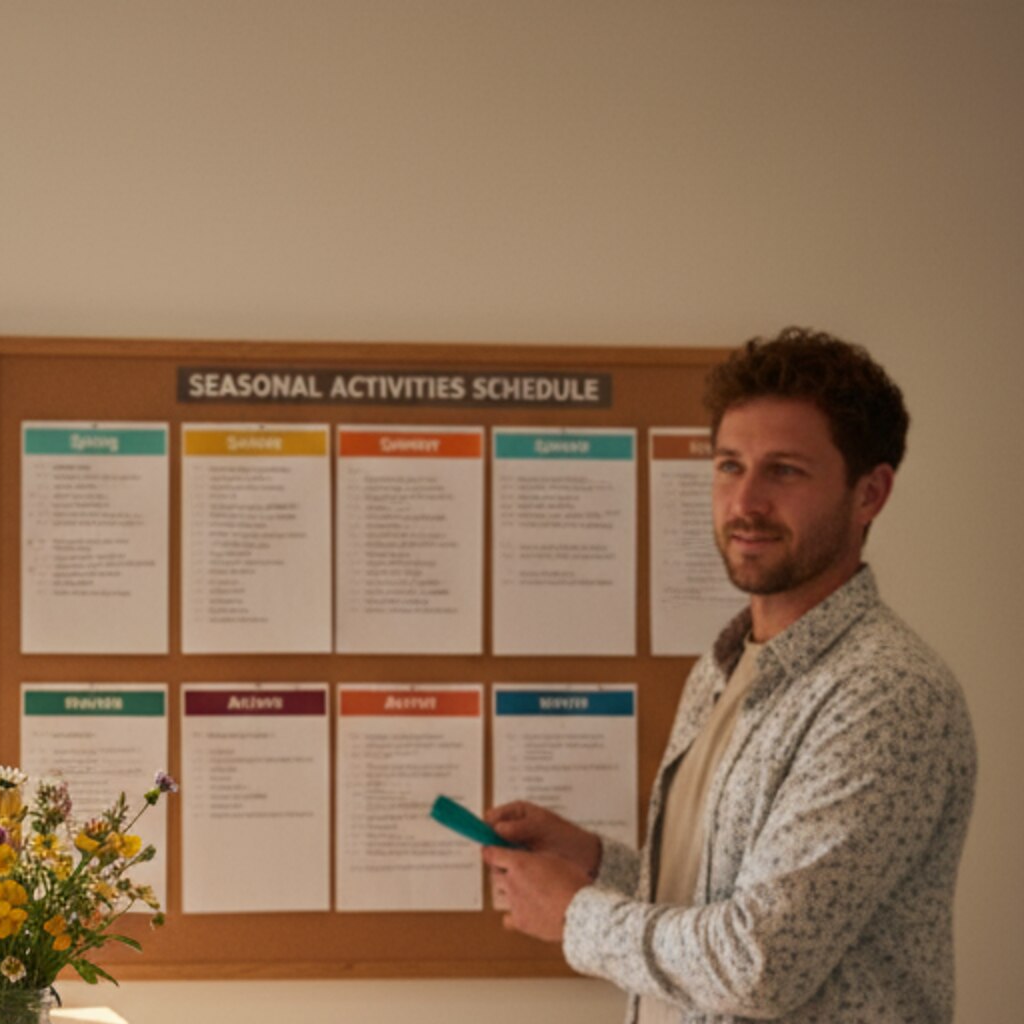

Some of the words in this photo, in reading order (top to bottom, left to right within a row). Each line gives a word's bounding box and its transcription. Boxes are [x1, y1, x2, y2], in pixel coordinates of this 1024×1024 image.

[188, 373, 321, 398] SEASONAL
[329, 374, 465, 399] ACTIVITIES
[472, 376, 599, 401] SCHEDULE
